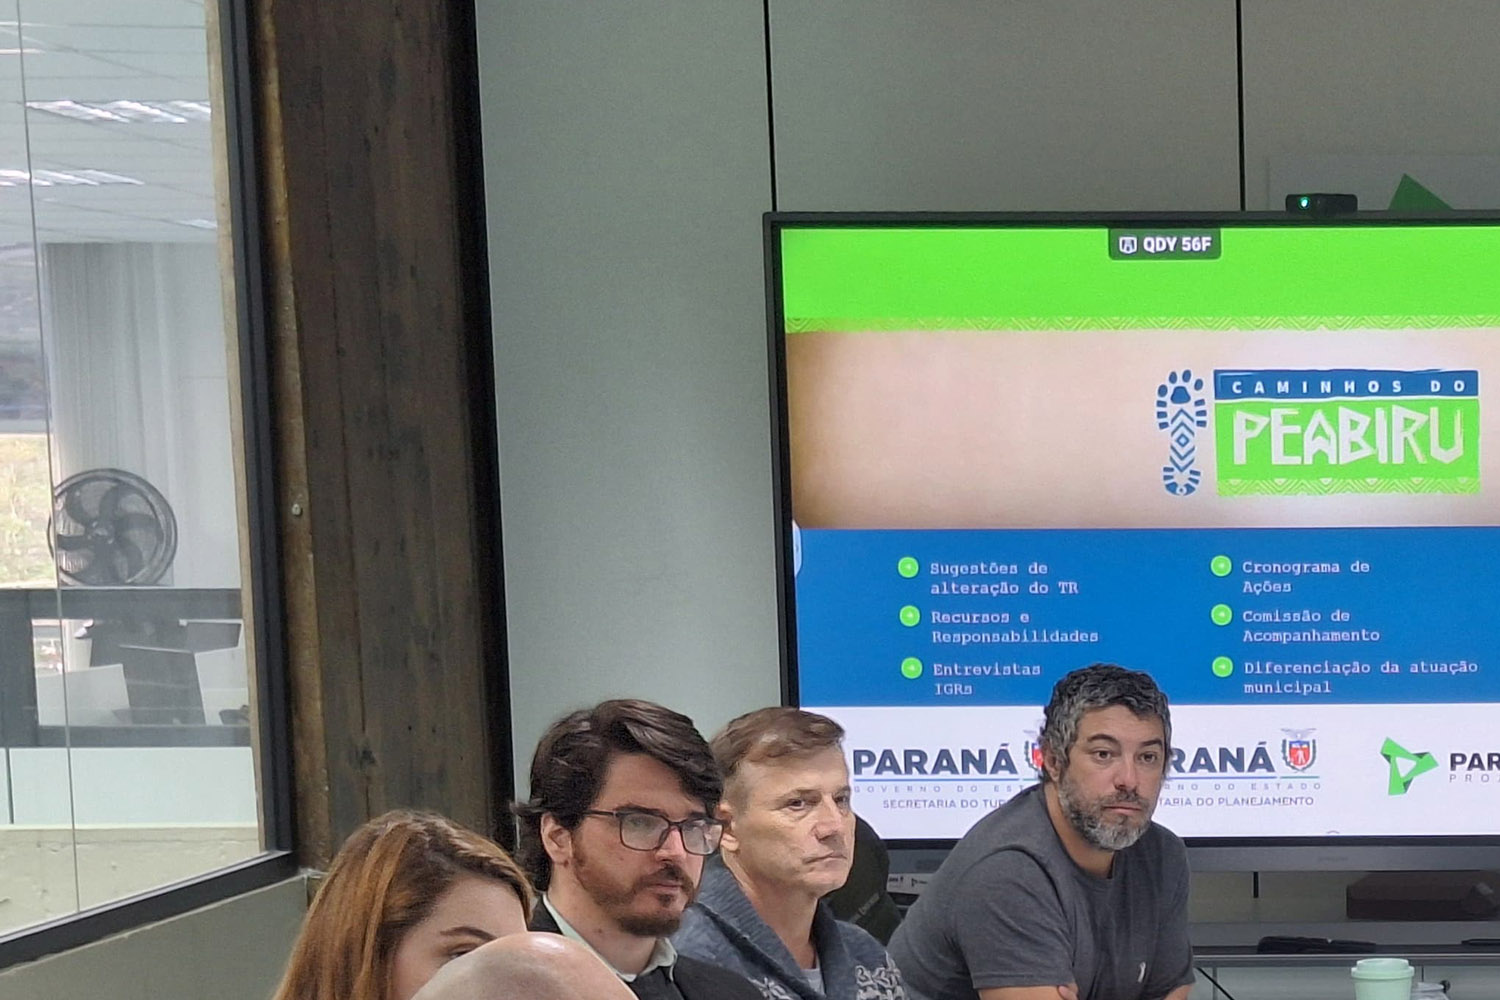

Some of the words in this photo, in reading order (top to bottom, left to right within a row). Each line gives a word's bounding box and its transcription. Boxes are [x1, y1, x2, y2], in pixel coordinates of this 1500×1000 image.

[1143, 236, 1177, 254] QDY
[1181, 236, 1212, 253] 56F
[1232, 380, 1402, 394] CAMINHOS
[1430, 380, 1465, 393] DO
[1233, 404, 1464, 465] PEABIRU
[930, 562, 1018, 577] Sugestões
[1028, 562, 1048, 575] de
[1242, 561, 1340, 576] Cronograma
[1350, 560, 1370, 573] de
[930, 581, 1019, 596] alteração
[1029, 581, 1049, 594] do
[1058, 581, 1079, 594] TR
[1243, 580, 1292, 595] Ações
[931, 611, 1010, 624] Recursos
[1020, 614, 1030, 623] e
[1243, 610, 1321, 622] Comissão
[1331, 609, 1350, 622] de
[932, 630, 1099, 645] Responsabilidades
[1243, 629, 1380, 644] Acompanhamento
[933, 663, 1041, 677] Entrevistas
[1244, 661, 1370, 676] Diferenciação
[1381, 661, 1399, 673] da
[1410, 661, 1478, 676] atuação
[935, 683, 973, 695] IGRs
[1244, 681, 1332, 695] municipal
[853, 742, 1018, 775] PARANÁ
[1170, 741, 1275, 773] RANÁ
[854, 785, 941, 793] GOVERNO
[1214, 783, 1235, 791] DO
[1251, 783, 1321, 791] ESTADO
[883, 799, 957, 809] SECRETARIA
[960, 799, 978, 808] DO
[1196, 797, 1214, 807] DO
[1218, 796, 1314, 806] PLANEJAMENTO
